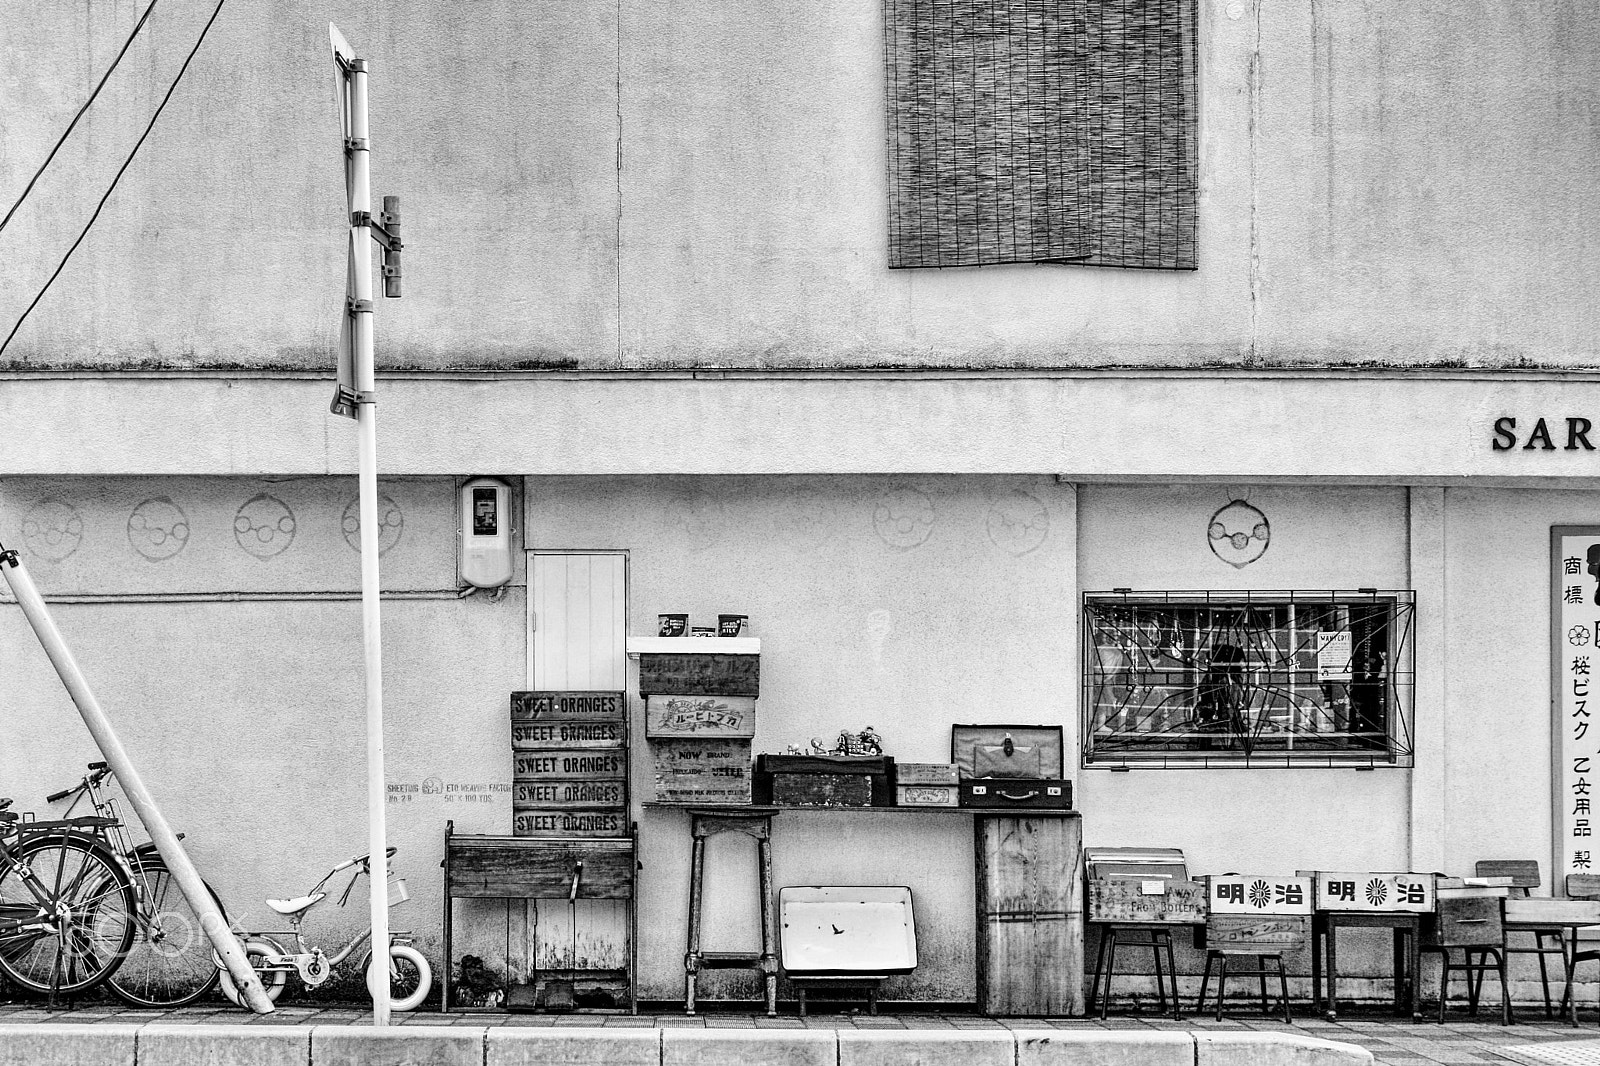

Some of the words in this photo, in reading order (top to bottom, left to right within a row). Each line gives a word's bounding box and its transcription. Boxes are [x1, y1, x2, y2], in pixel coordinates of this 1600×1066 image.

[1492, 417, 1597, 450] SAR
[1563, 556, 1584, 604] 商標
[515, 696, 555, 713] SWEET
[560, 697, 616, 713] ORANGES
[1571, 656, 1591, 741] 桜ビスク
[515, 726, 555, 741] SWEET
[560, 725, 616, 741] ORANGES
[517, 757, 557, 773] SWEET
[563, 756, 618, 773] ORANGES
[519, 786, 558, 801] SWEET
[564, 786, 619, 801] ORANGES
[1572, 757, 1592, 837] 乙女用品
[517, 815, 557, 831] SWEET
[563, 815, 618, 831] ORANGES
[1166, 886, 1197, 898] AWAY
[1217, 883, 1303, 904] 明治
[1328, 881, 1425, 903] 明治
